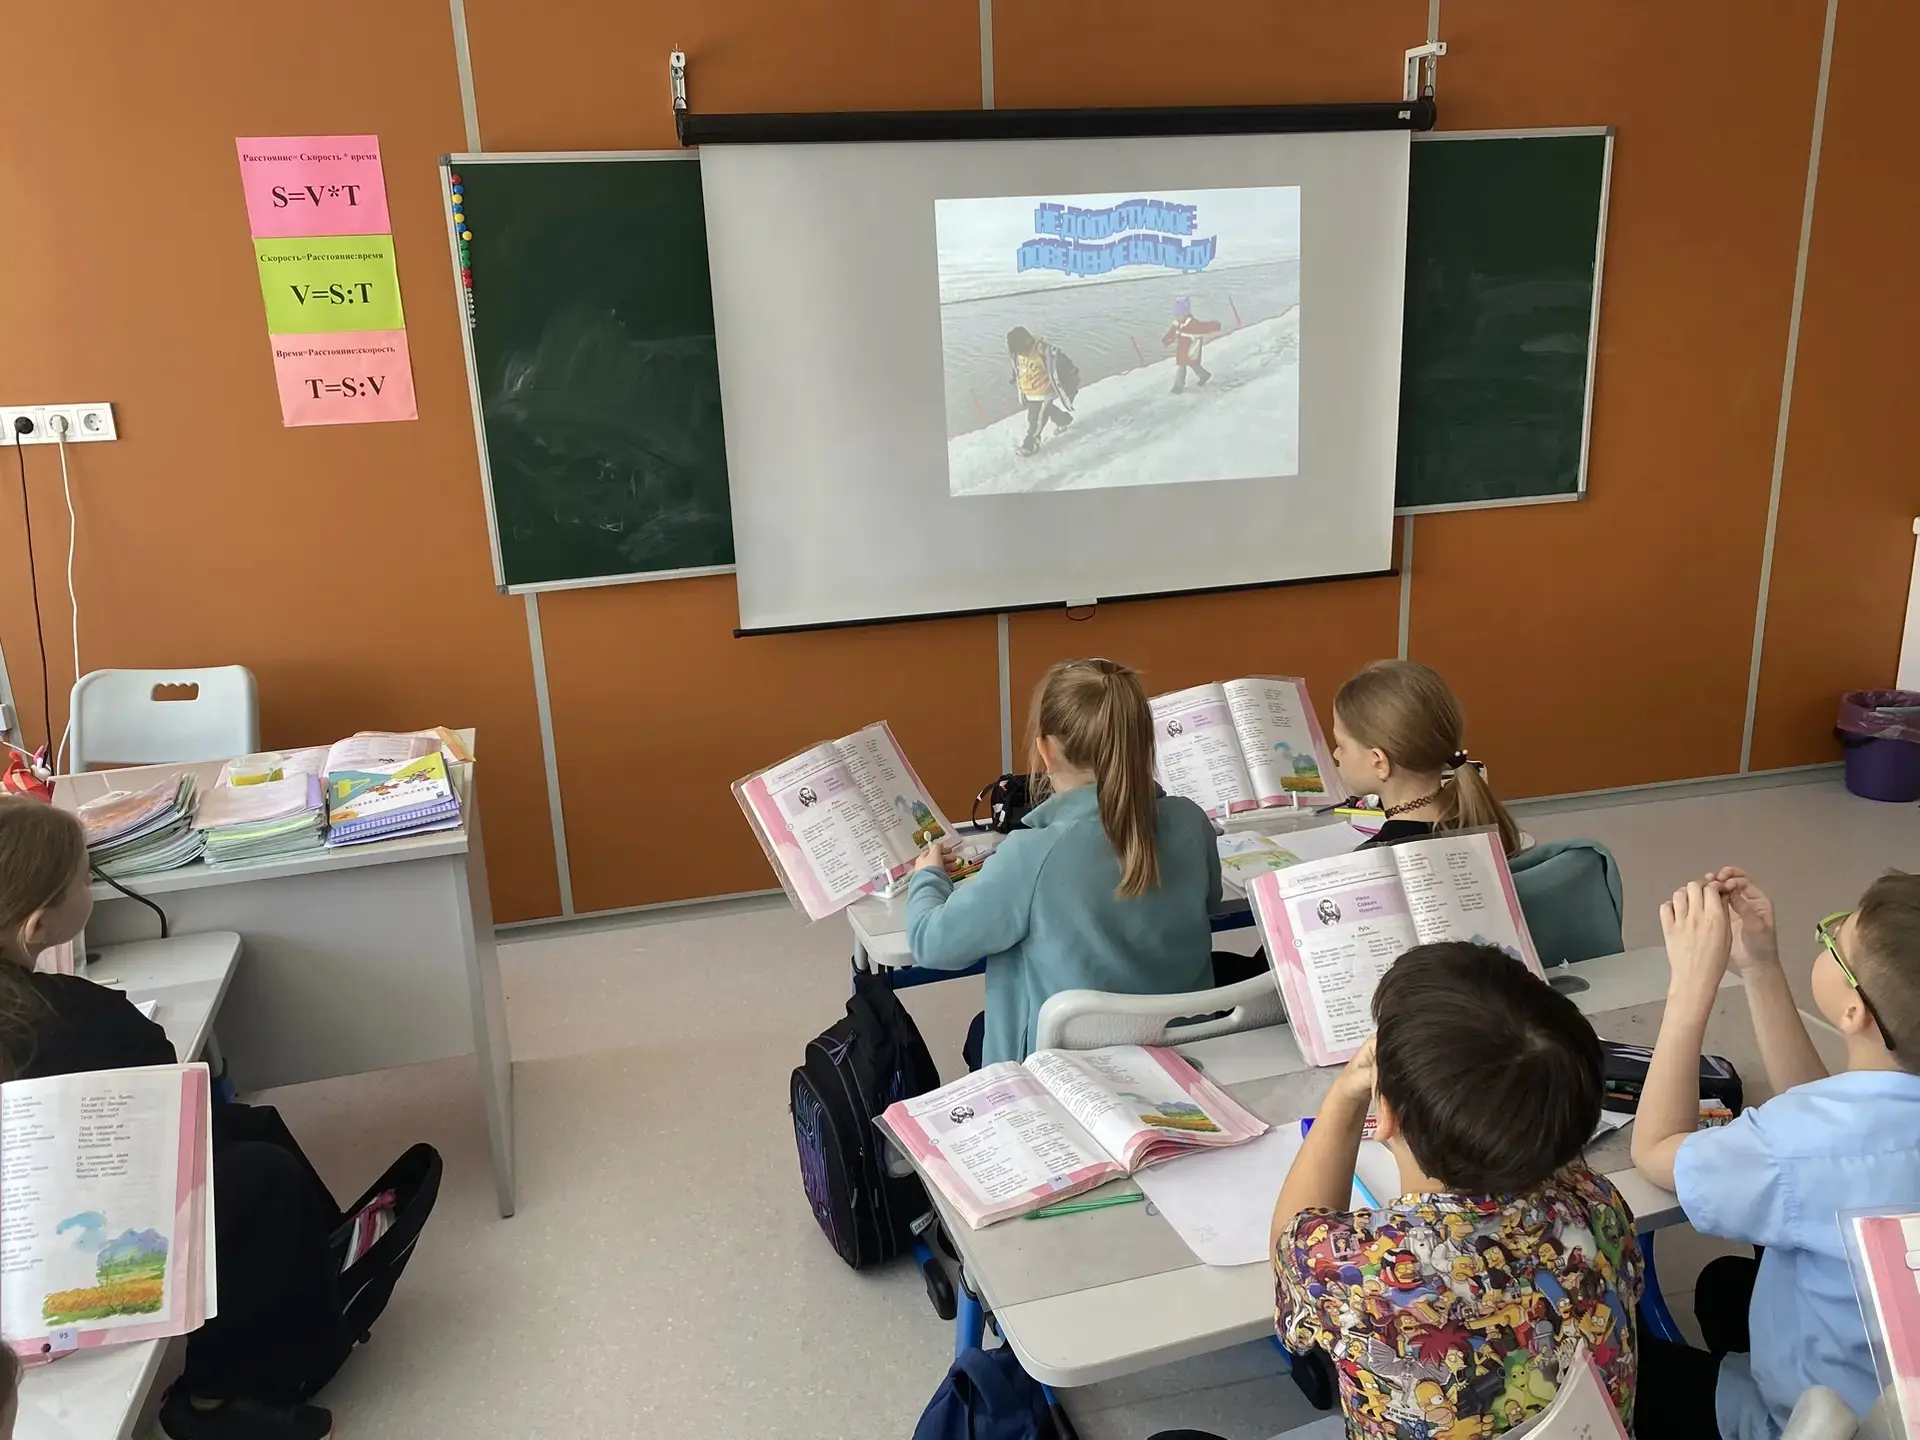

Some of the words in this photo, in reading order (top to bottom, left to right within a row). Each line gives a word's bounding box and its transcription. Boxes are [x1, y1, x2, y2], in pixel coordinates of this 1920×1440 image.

[300, 153, 342, 162] Скорость
[351, 153, 378, 162] время
[289, 282, 373, 305] V=S:T
[305, 375, 386, 399] T=S:V
[59, 1331, 69, 1339] 95
